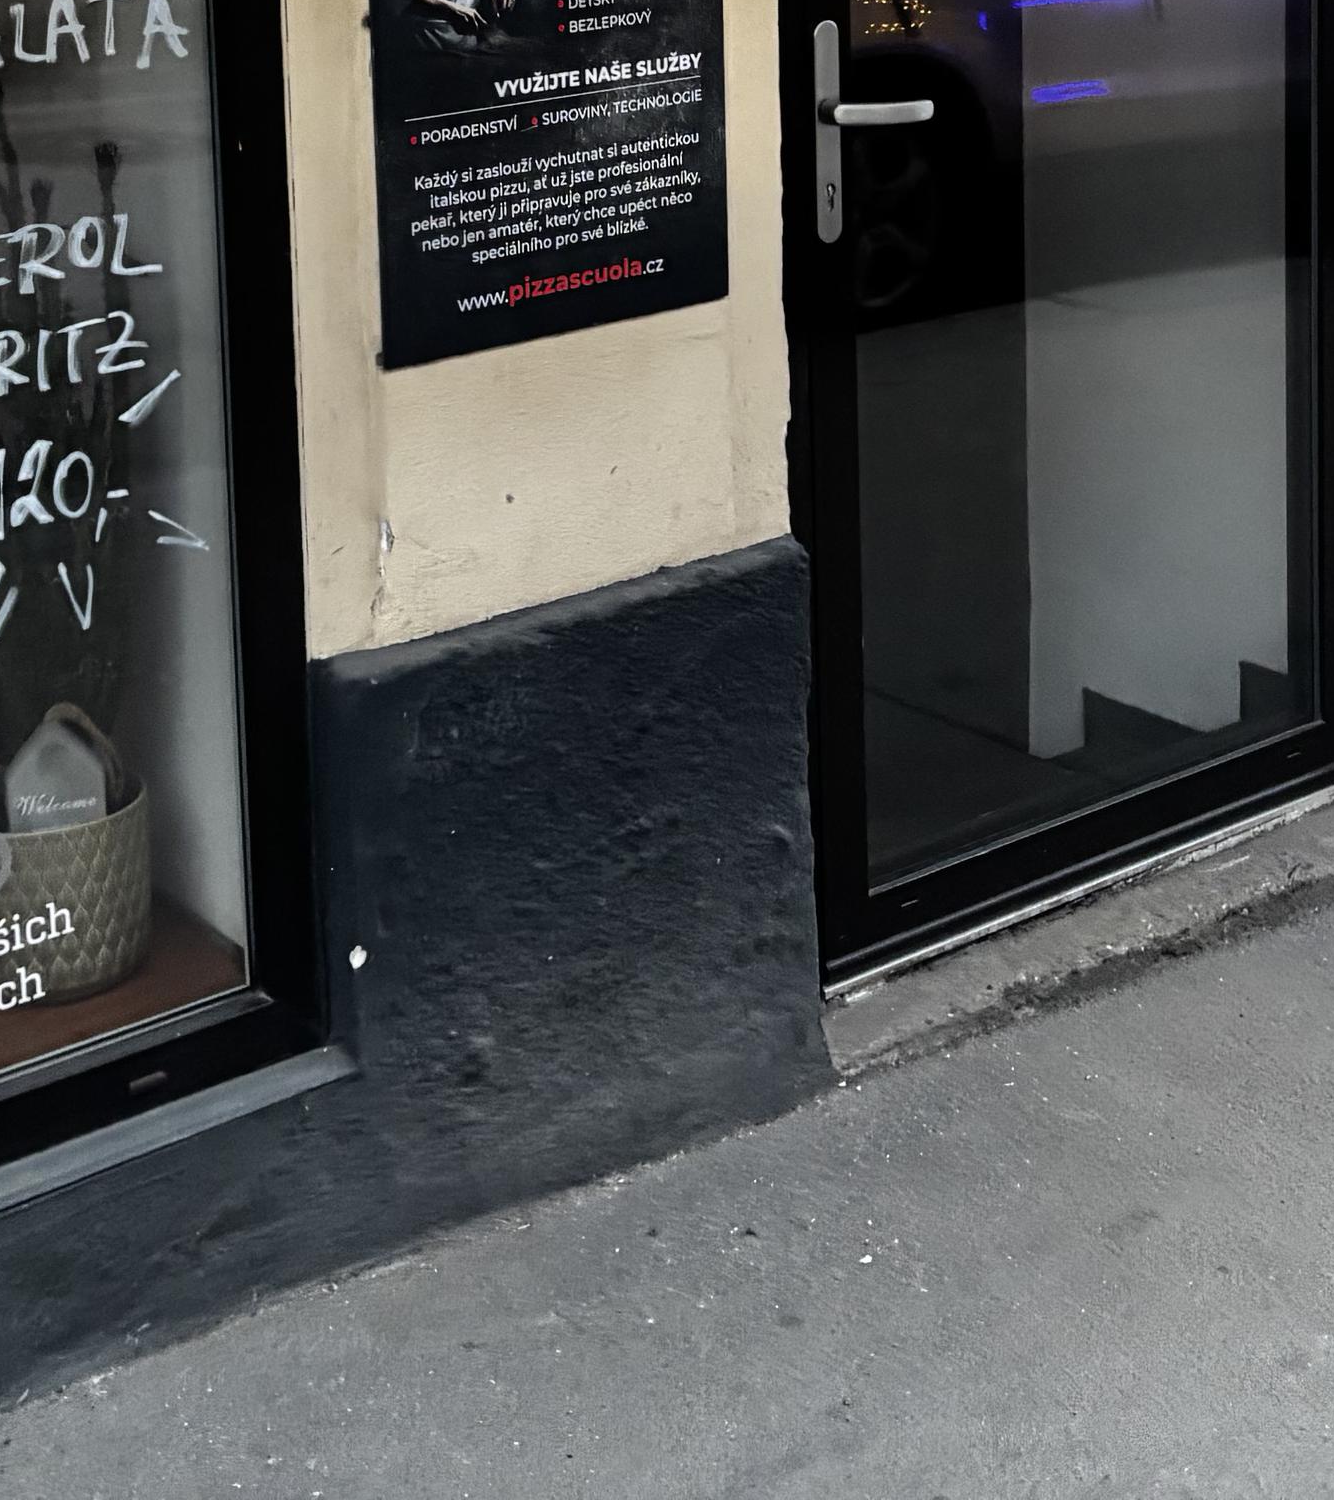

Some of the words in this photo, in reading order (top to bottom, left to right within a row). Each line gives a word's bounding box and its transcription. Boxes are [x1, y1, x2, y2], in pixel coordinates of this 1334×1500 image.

[569, 11, 651, 33] BEZLEPKOVÝ
[495, 70, 580, 98] VYUŽIJTE
[585, 62, 631, 86] NAŠE
[637, 53, 702, 76] SLUŽBY
[421, 116, 517, 145] PORADENSTVÍ
[542, 103, 610, 126] SUROVINY,
[613, 89, 702, 114] TECHNOLOGIE
[415, 172, 458, 190] Každý
[461, 170, 473, 183] si
[477, 159, 531, 180] zaslouží
[536, 149, 604, 173] vychutnat
[607, 143, 618, 158] si
[621, 132, 699, 155] autentickou
[430, 188, 486, 208] italskou
[490, 181, 530, 199] pizzu,
[533, 174, 547, 190] ať
[552, 173, 567, 188] už
[571, 171, 594, 188] jste
[598, 152, 683, 180] profesionální
[457, 257, 664, 312] www.pizzascuola.cz
